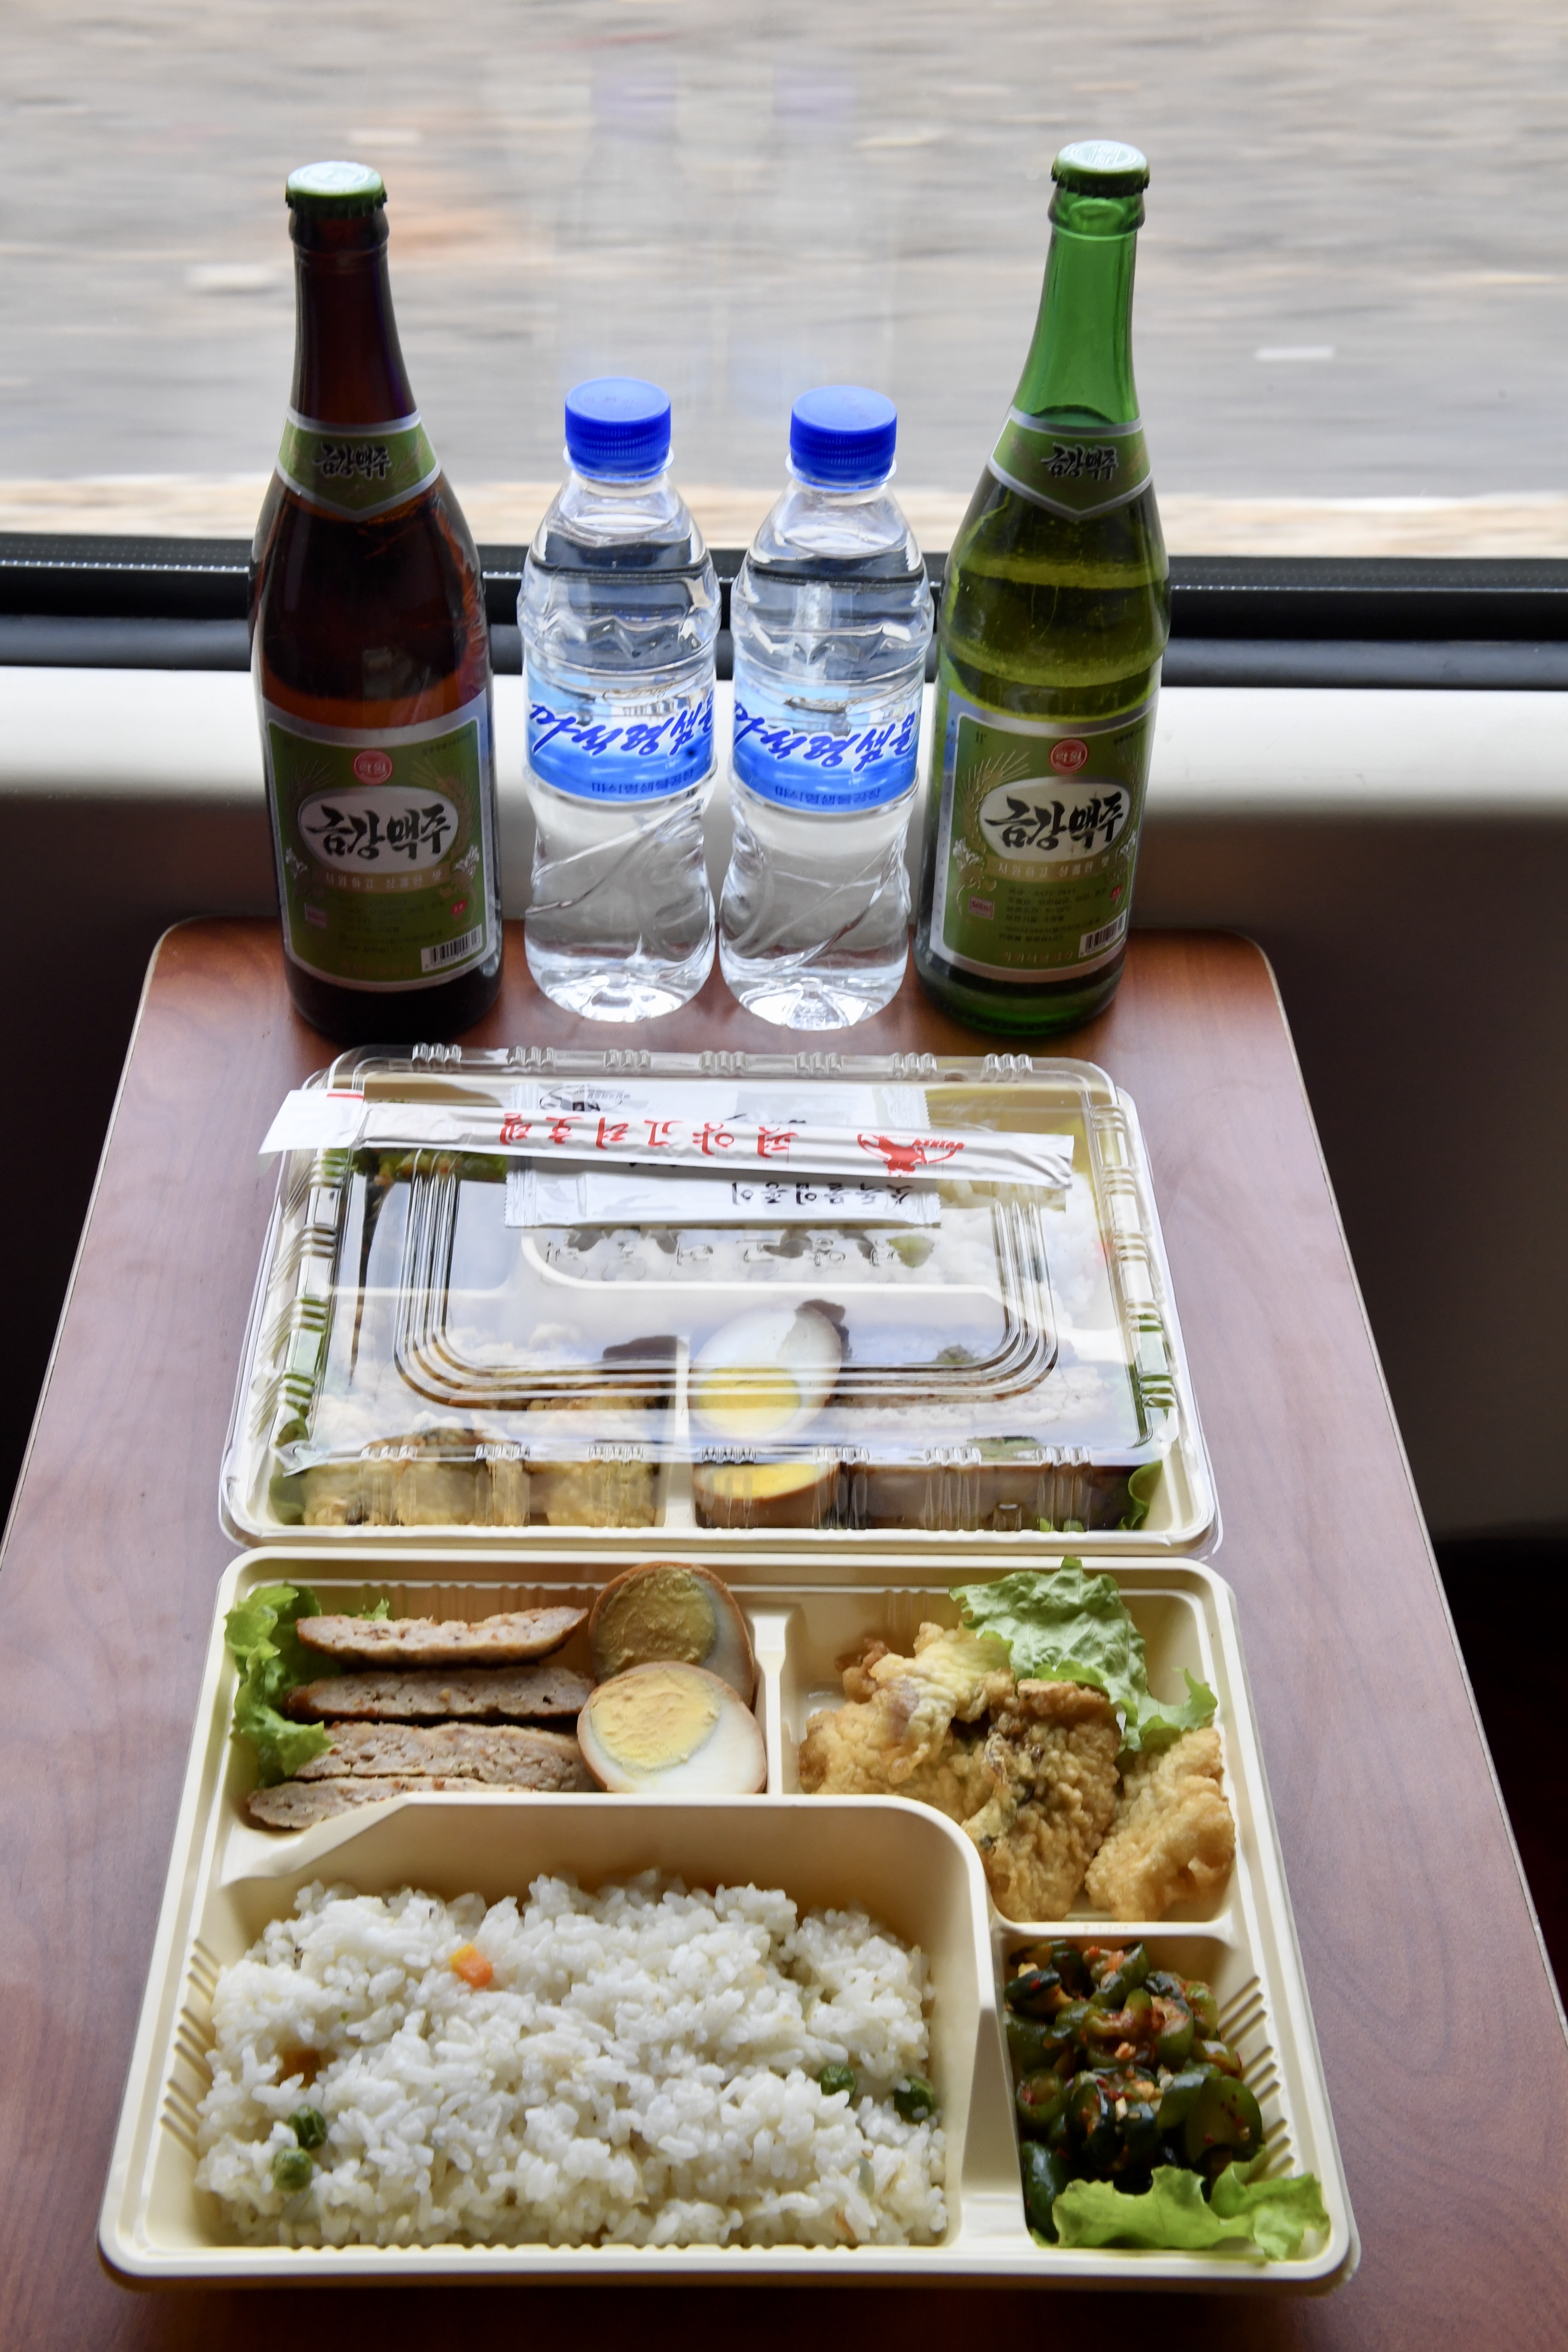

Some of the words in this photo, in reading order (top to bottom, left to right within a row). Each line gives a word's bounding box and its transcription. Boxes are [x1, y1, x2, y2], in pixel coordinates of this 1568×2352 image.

[314, 442, 391, 479] 금강맥주
[1041, 442, 1119, 481] 금강맥주
[308, 803, 452, 861] 금강맥주
[985, 791, 1124, 852] 금강맥주
[499, 1113, 799, 1159] 평양고려호텔
